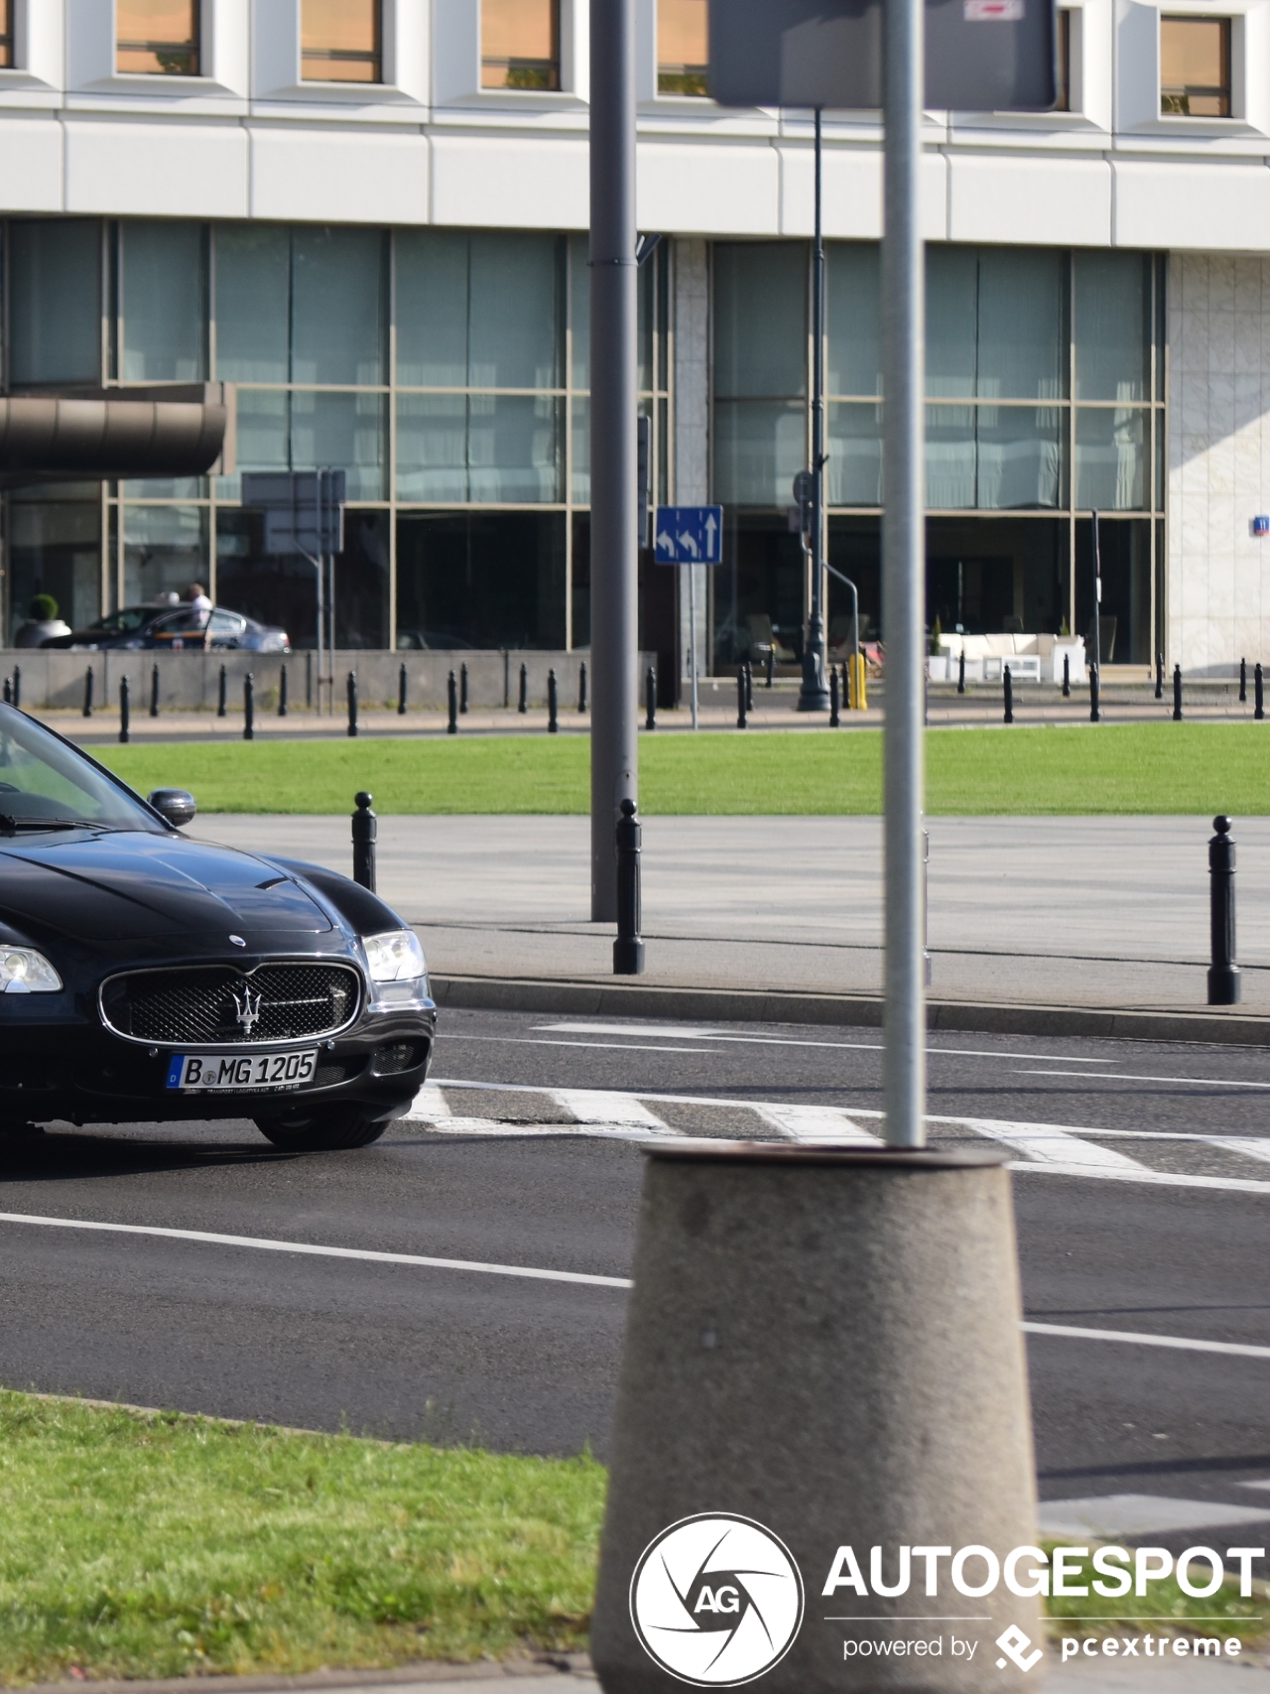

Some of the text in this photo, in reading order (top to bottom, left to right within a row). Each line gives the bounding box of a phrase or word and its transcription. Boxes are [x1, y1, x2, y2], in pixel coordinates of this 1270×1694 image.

[184, 1053, 315, 1084] B MG 1205
